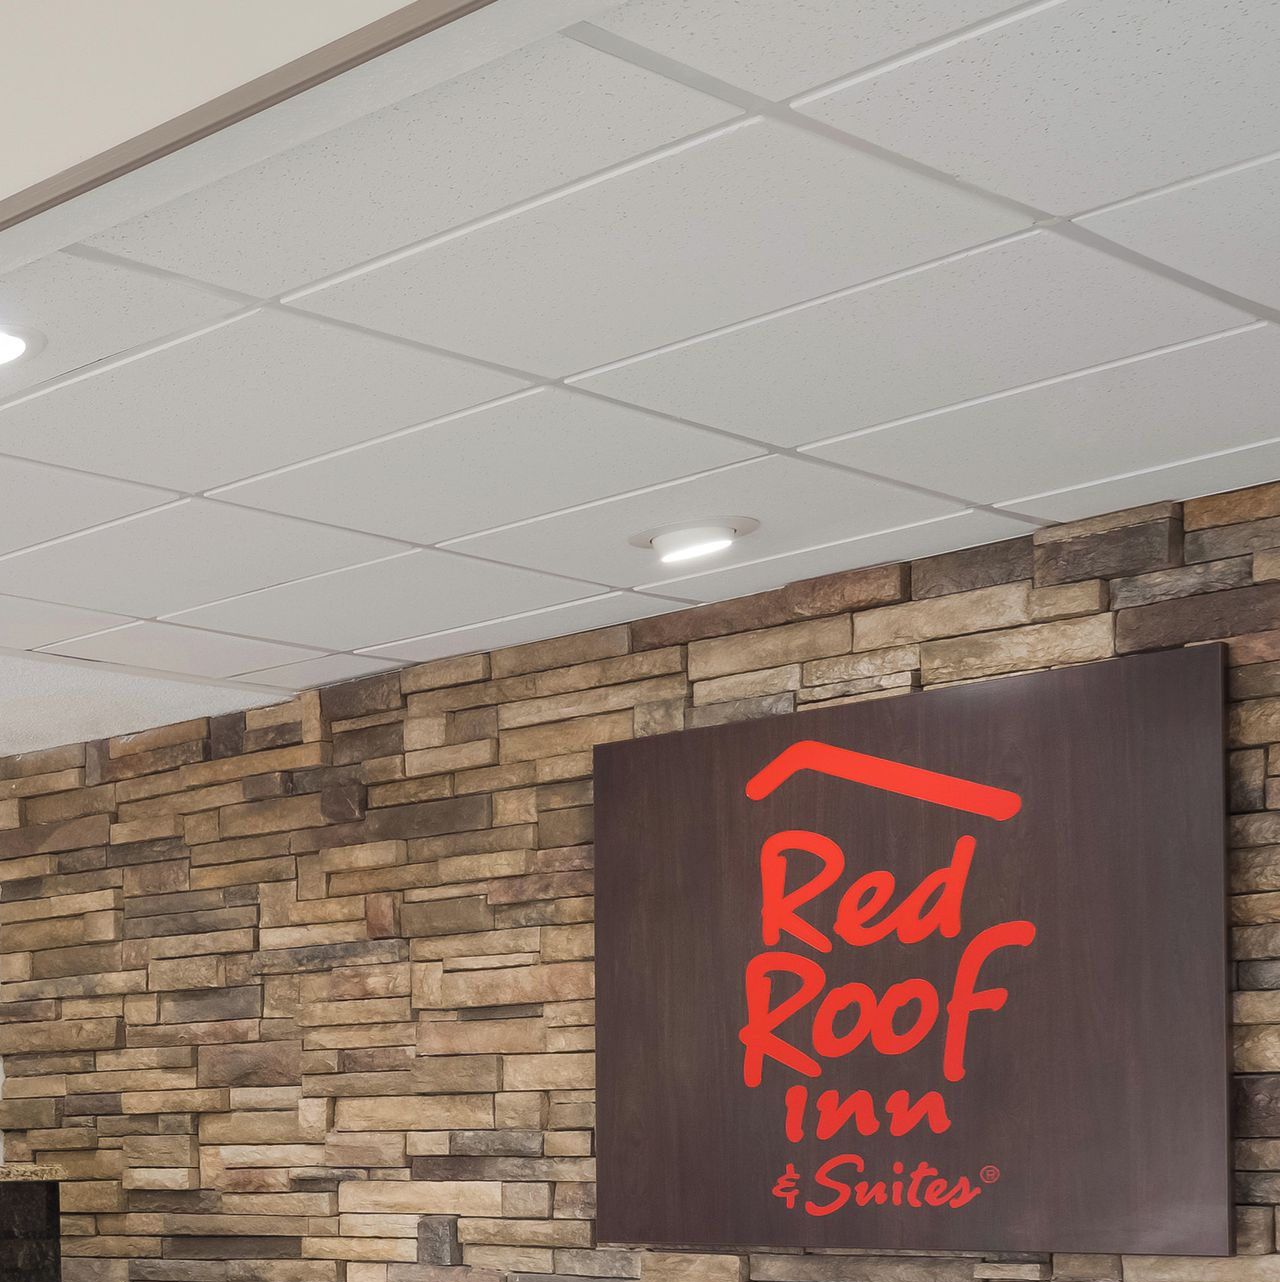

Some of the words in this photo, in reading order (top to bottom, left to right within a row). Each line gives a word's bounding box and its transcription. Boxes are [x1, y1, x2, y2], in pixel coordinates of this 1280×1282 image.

[759, 828, 976, 954] Red
[738, 919, 1037, 1088] Roof
[771, 1162, 801, 1209] &
